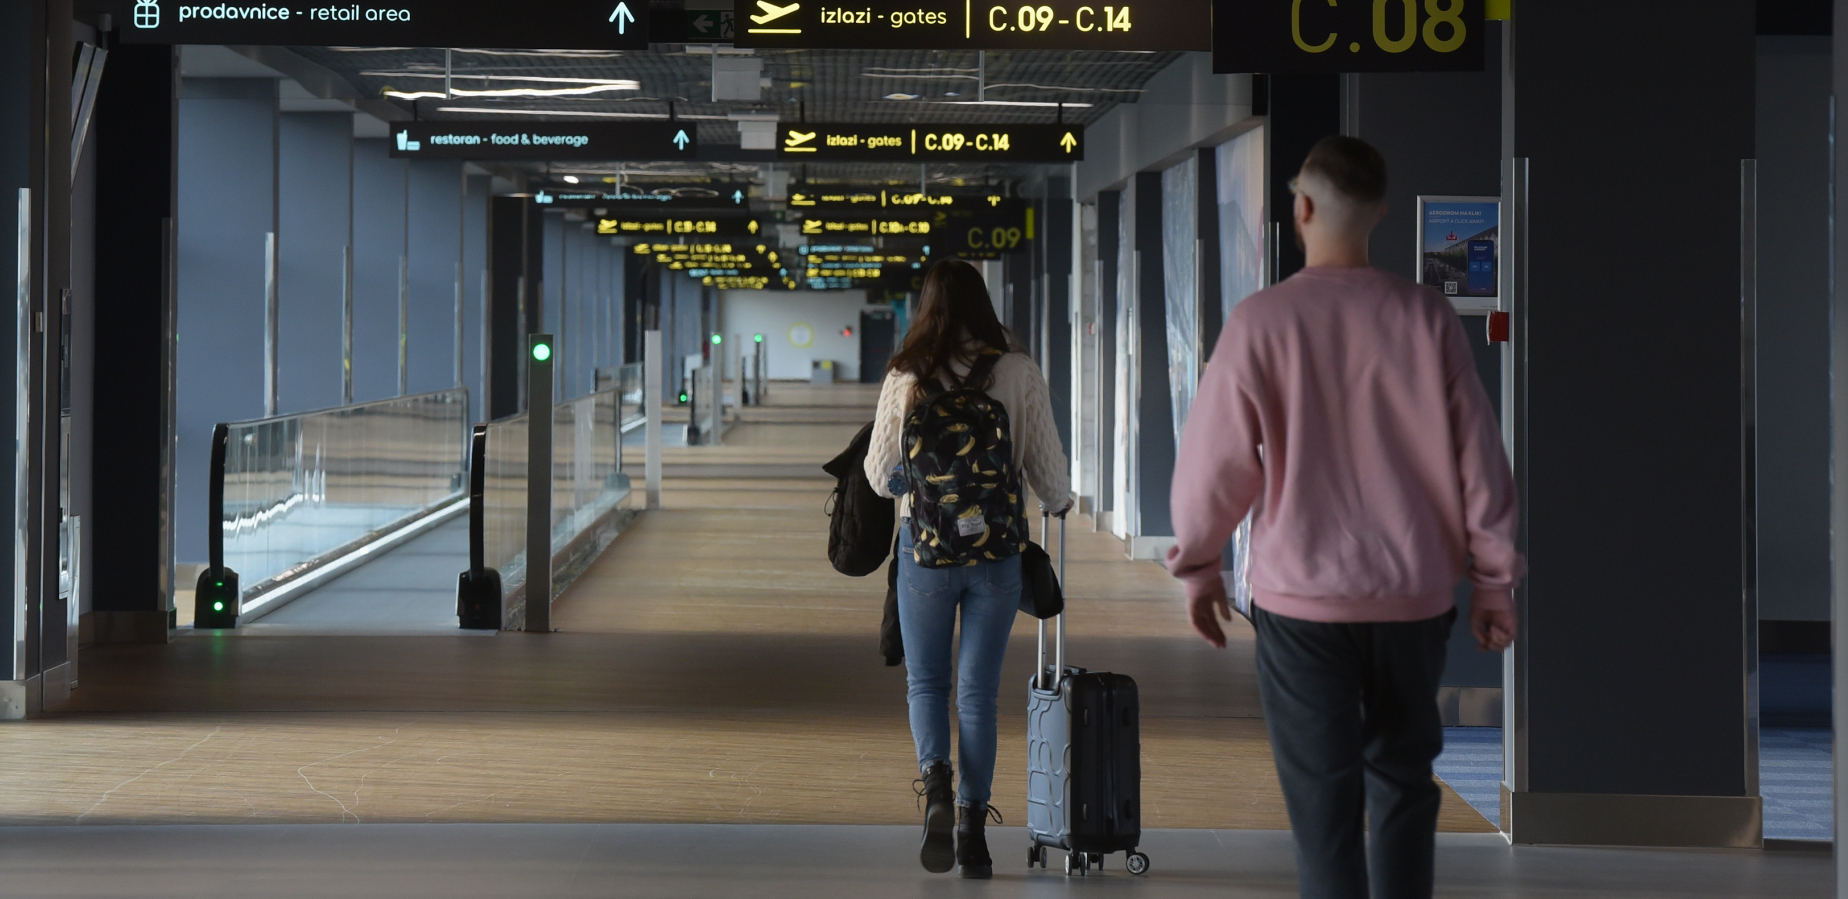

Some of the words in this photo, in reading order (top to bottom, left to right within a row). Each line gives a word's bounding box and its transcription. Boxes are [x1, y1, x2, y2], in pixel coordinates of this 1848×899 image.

[179, 3, 290, 22] prodavnice
[310, 4, 360, 21] retail
[365, 8, 411, 21] area
[820, 6, 871, 24] izlazi
[890, 8, 947, 28] gates
[989, 5, 1054, 32] C.09
[1075, 5, 1132, 32] C.14
[1291, 0, 1467, 53] C.08
[430, 134, 481, 146] restoran
[491, 133, 519, 146] food
[520, 134, 532, 146] &
[533, 133, 589, 148] beverage
[826, 134, 858, 147] izlazi
[867, 136, 903, 150] gates
[924, 133, 965, 151] C.09
[975, 133, 1010, 151] C.14
[967, 227, 1021, 249] C.09
